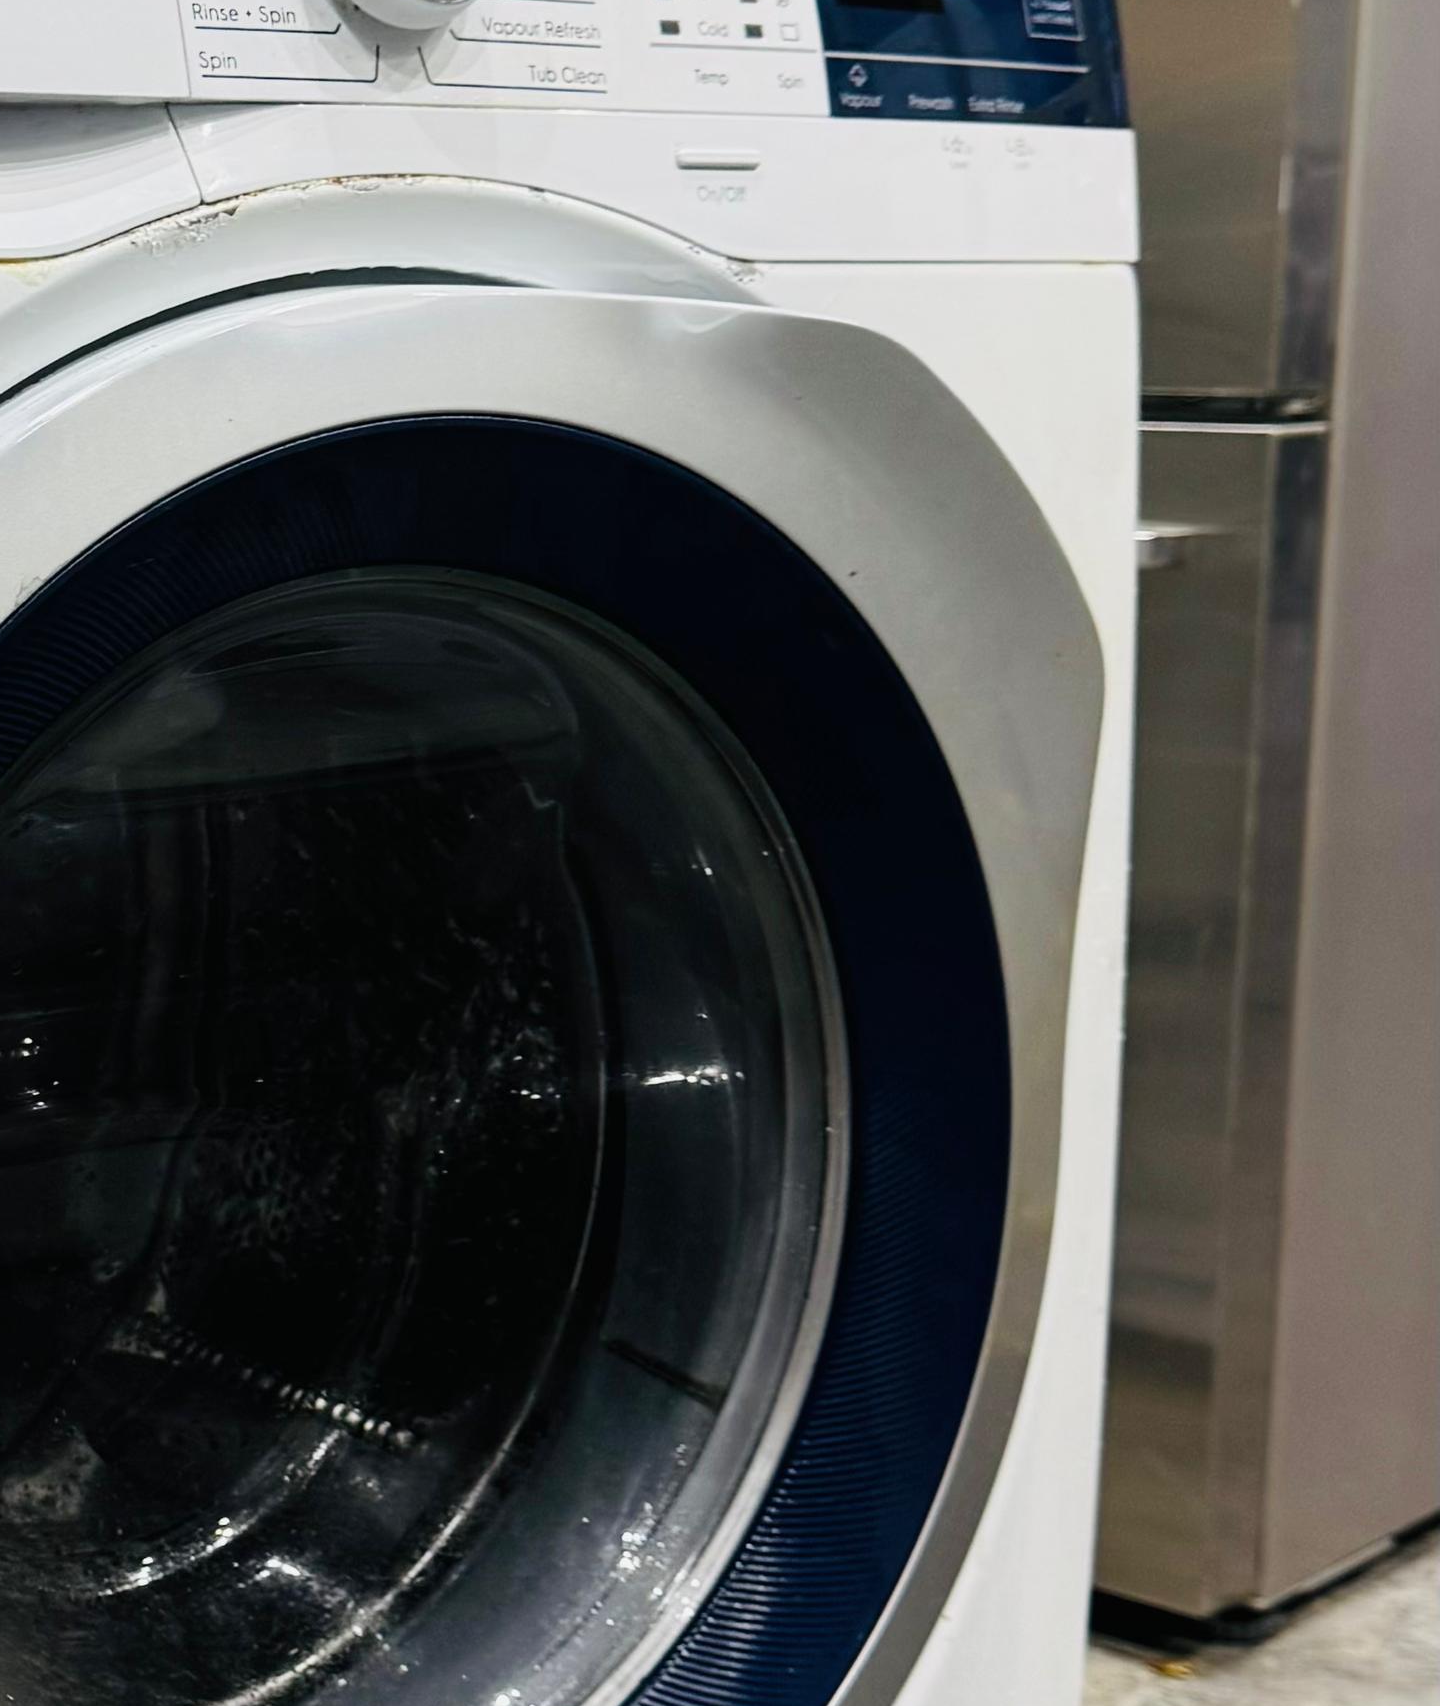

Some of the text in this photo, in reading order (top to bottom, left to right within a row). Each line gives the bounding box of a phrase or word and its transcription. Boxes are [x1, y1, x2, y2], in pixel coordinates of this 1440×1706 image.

[192, 3, 239, 22] Rinse
[259, 6, 297, 26] Spin
[481, 16, 602, 40] Vapour Refresh
[697, 20, 730, 38] Cold
[198, 50, 238, 71] Spin
[528, 64, 608, 85] Tub Clean
[694, 69, 730, 87] Temp
[776, 72, 804, 90] Spin
